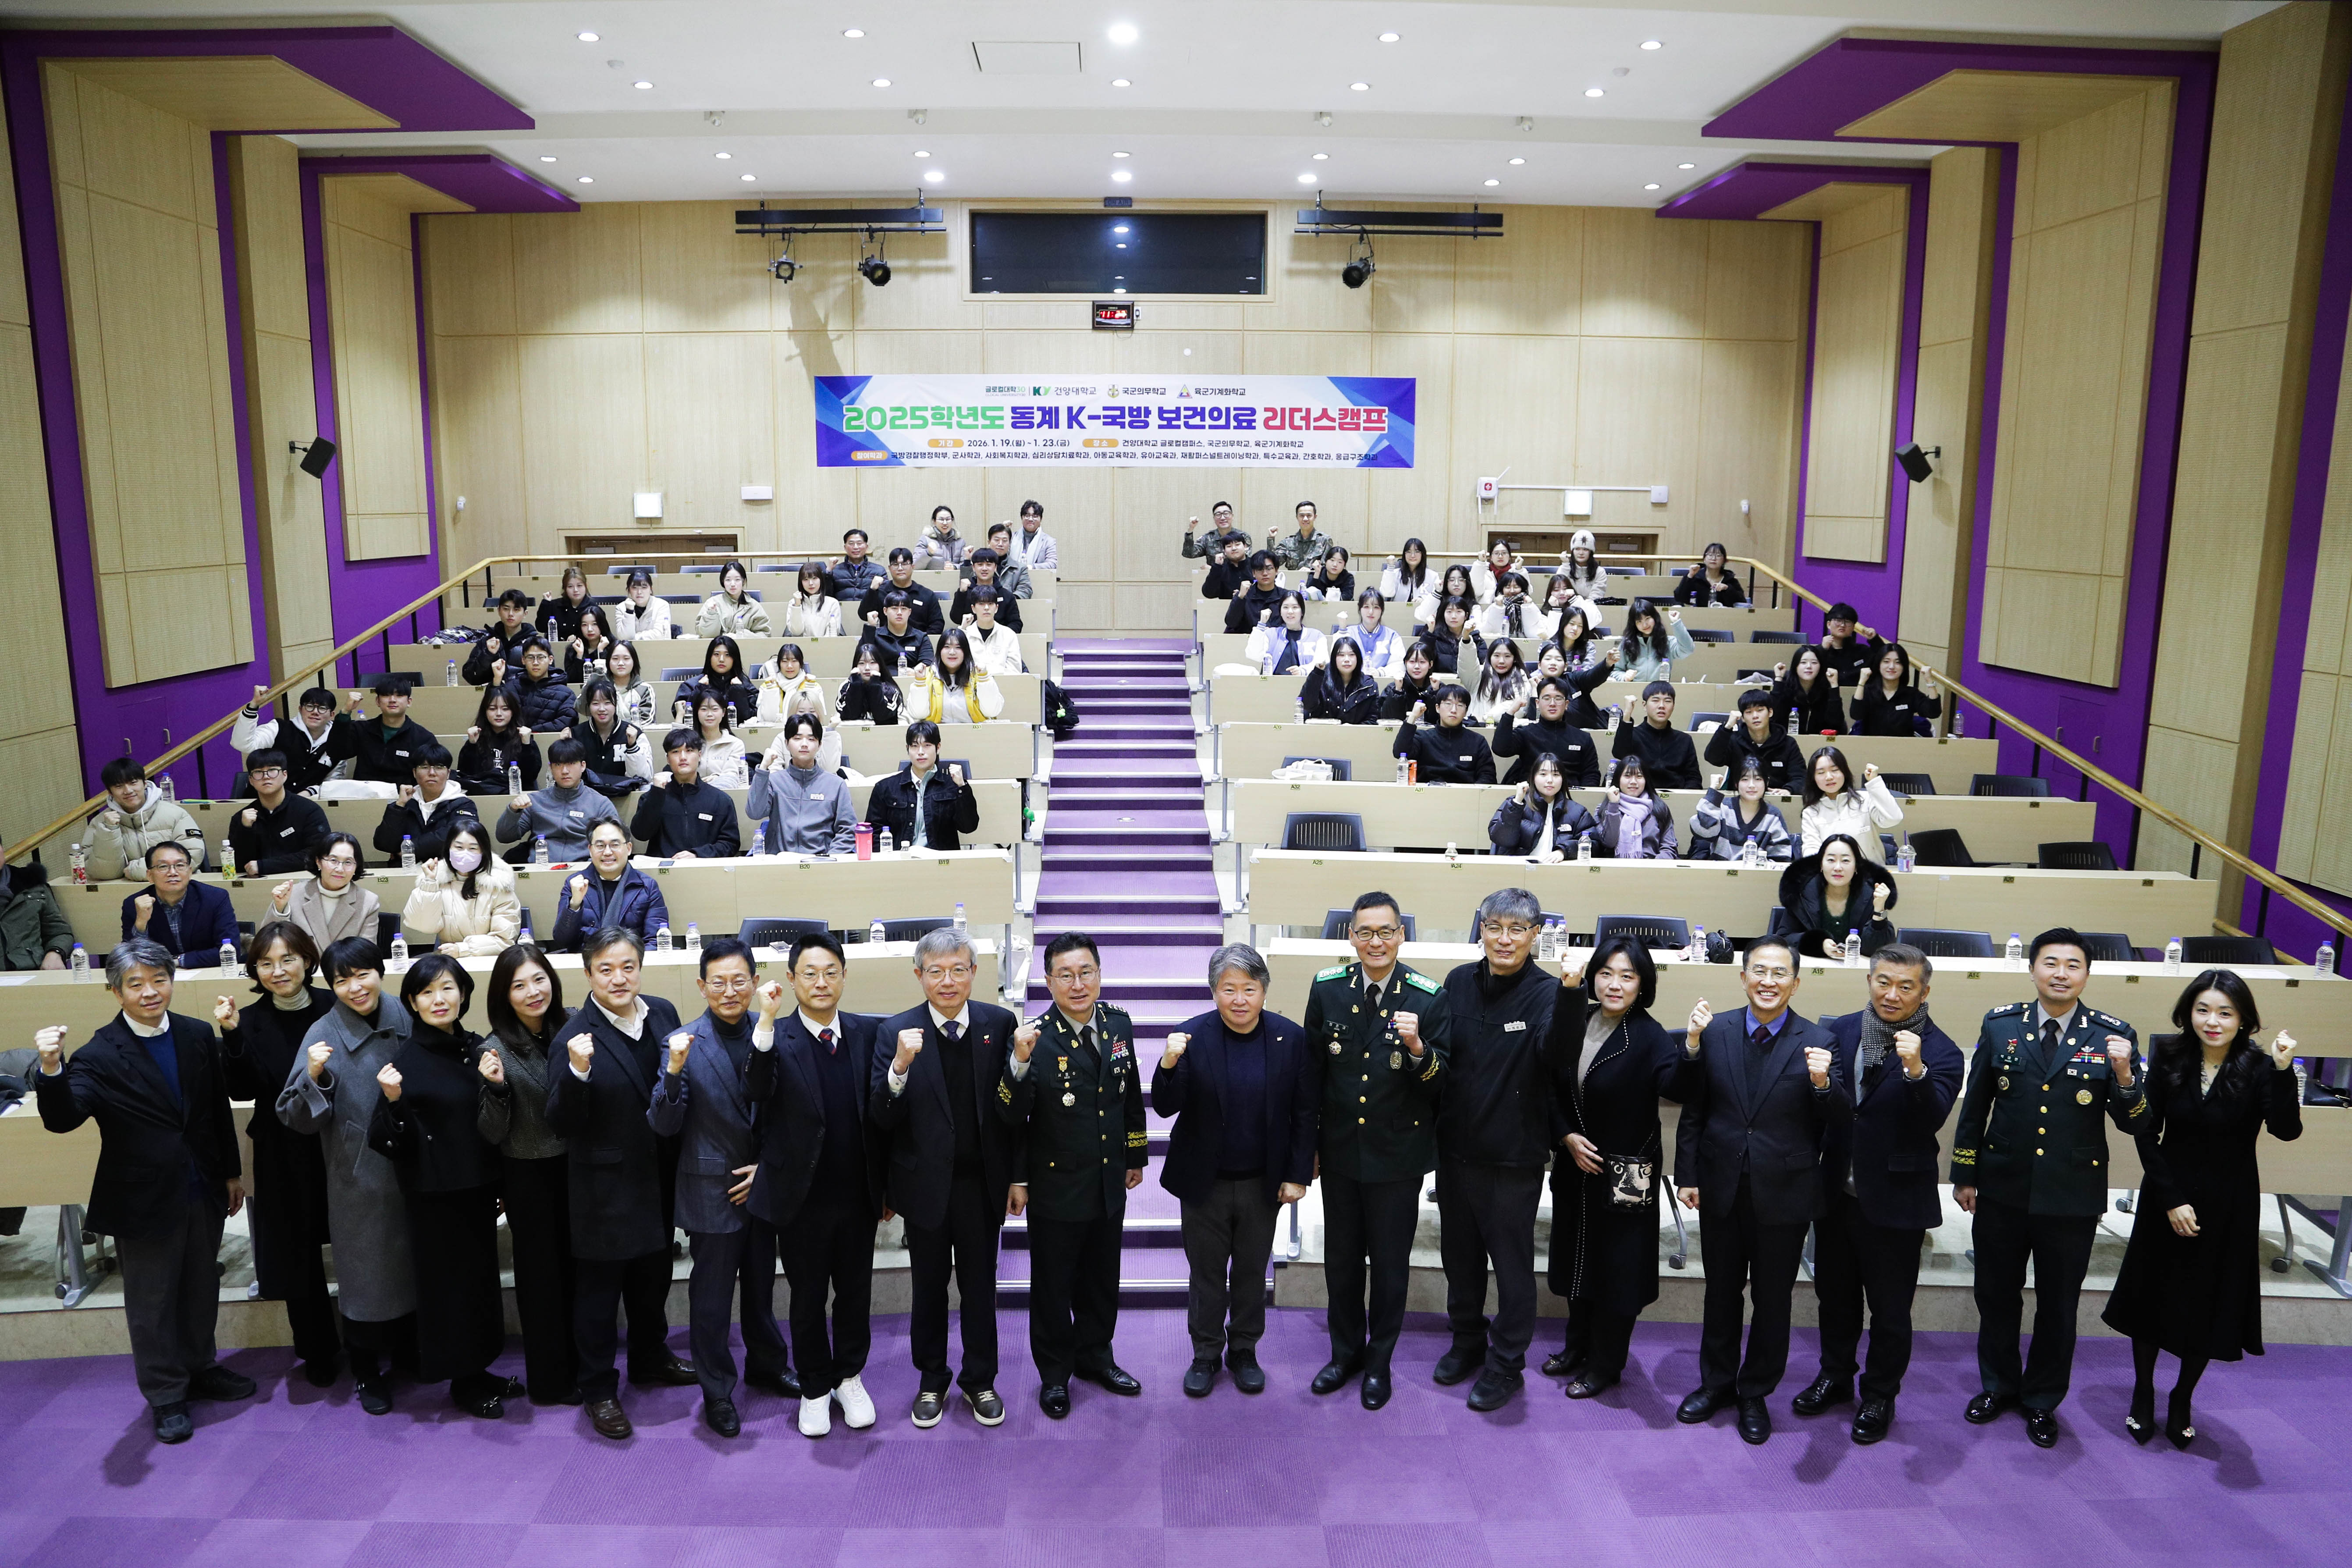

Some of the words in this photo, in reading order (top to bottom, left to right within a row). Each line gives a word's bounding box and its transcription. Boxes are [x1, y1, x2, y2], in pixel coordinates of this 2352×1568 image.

[1055, 386, 1096, 395] 건양대학교
[1122, 387, 1166, 395] 국군의무학교
[1194, 388, 1246, 396] 육군기계화학교
[845, 405, 1005, 430] 2025학년도
[1011, 406, 1059, 430] 동계
[1158, 406, 1256, 430] 보건의료
[1263, 407, 1386, 432] 리더스캠프
[1420, 583, 1430, 594] K
[1375, 640, 1390, 654] K
[613, 744, 628, 762] K
